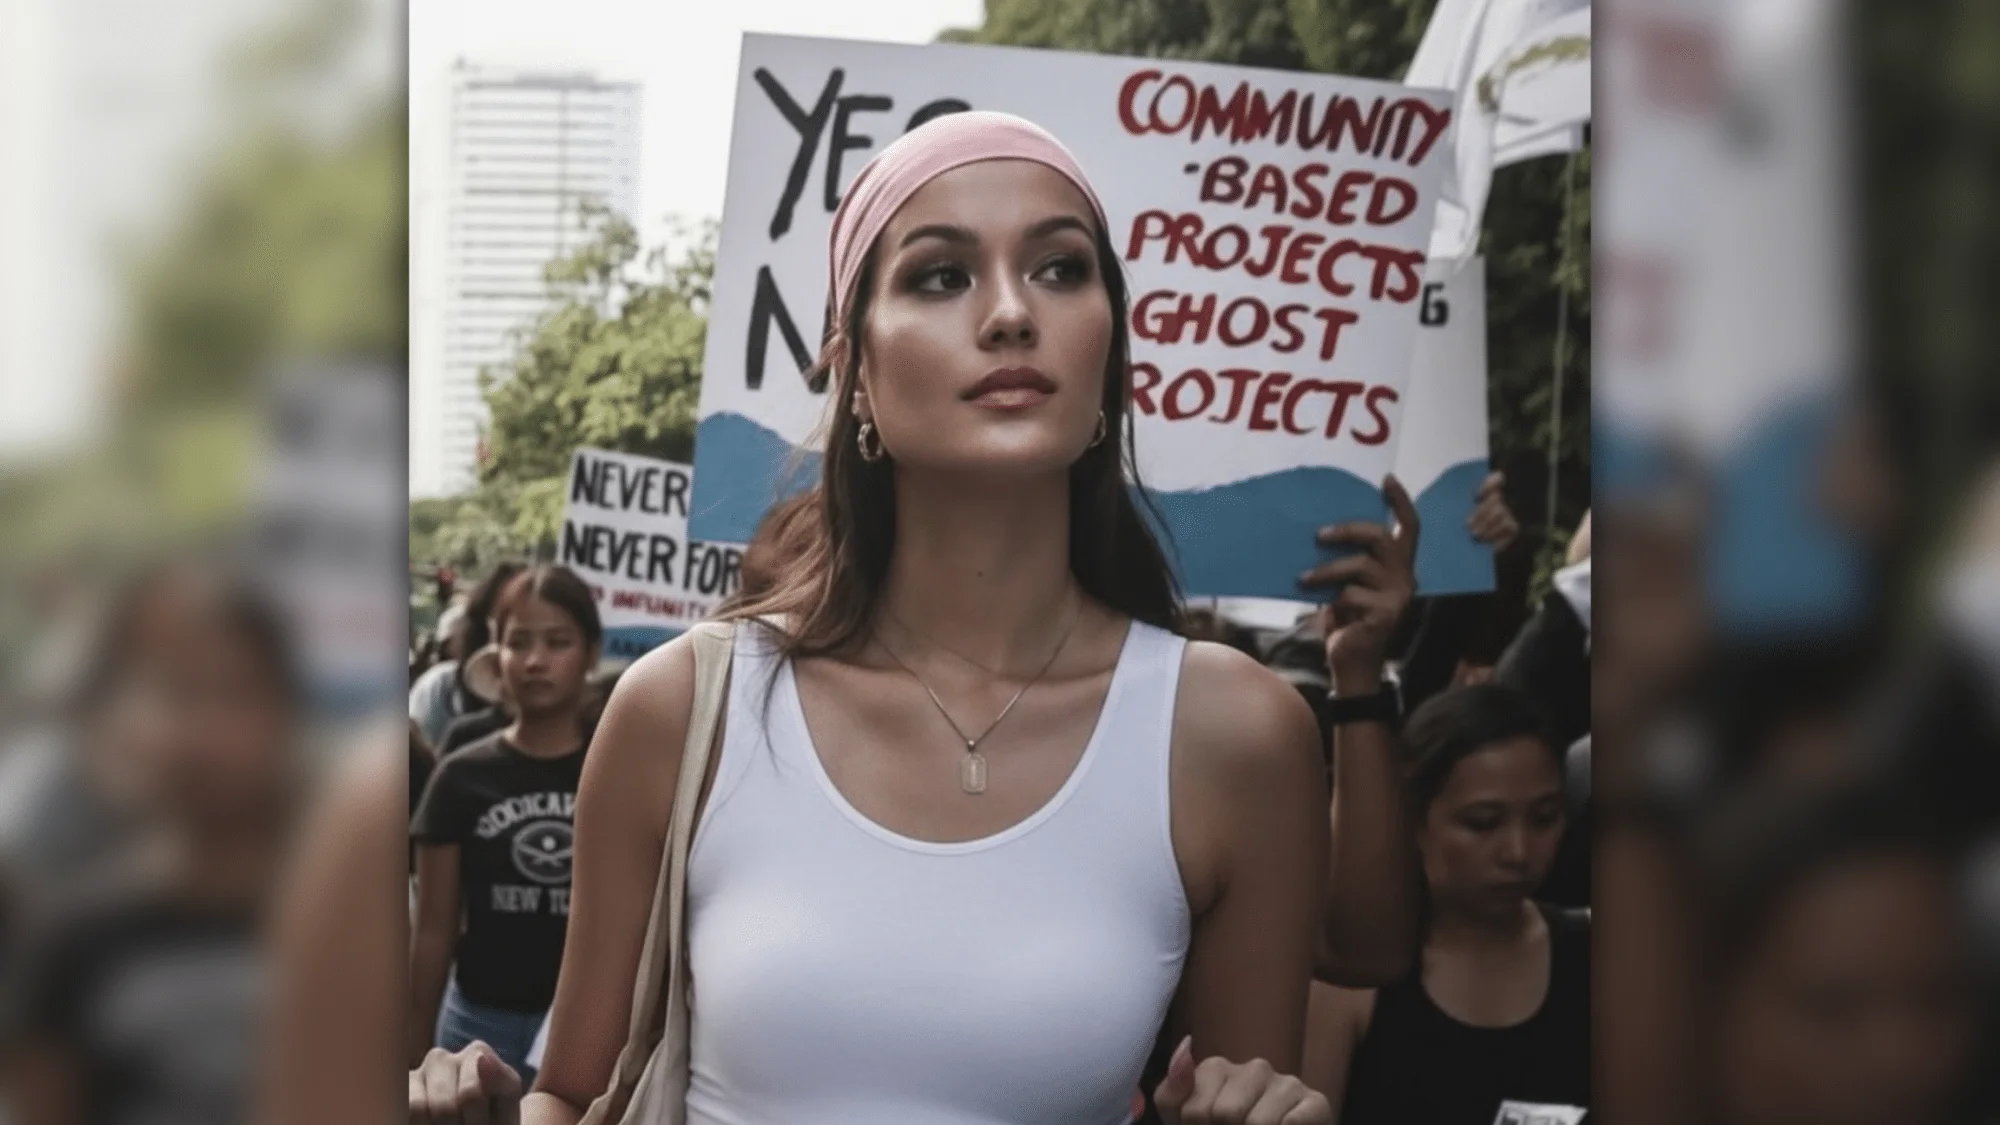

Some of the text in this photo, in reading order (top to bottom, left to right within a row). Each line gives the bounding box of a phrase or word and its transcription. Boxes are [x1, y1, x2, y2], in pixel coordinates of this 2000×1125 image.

[1118, 69, 1452, 167] COMMUNITY
[754, 67, 972, 241] YE
[1126, 210, 1426, 303] PROJECTS
[1132, 290, 1359, 361] GHOST
[572, 454, 688, 517] NEVER
[563, 520, 677, 584] NEVER
[490, 883, 542, 913] NEW
